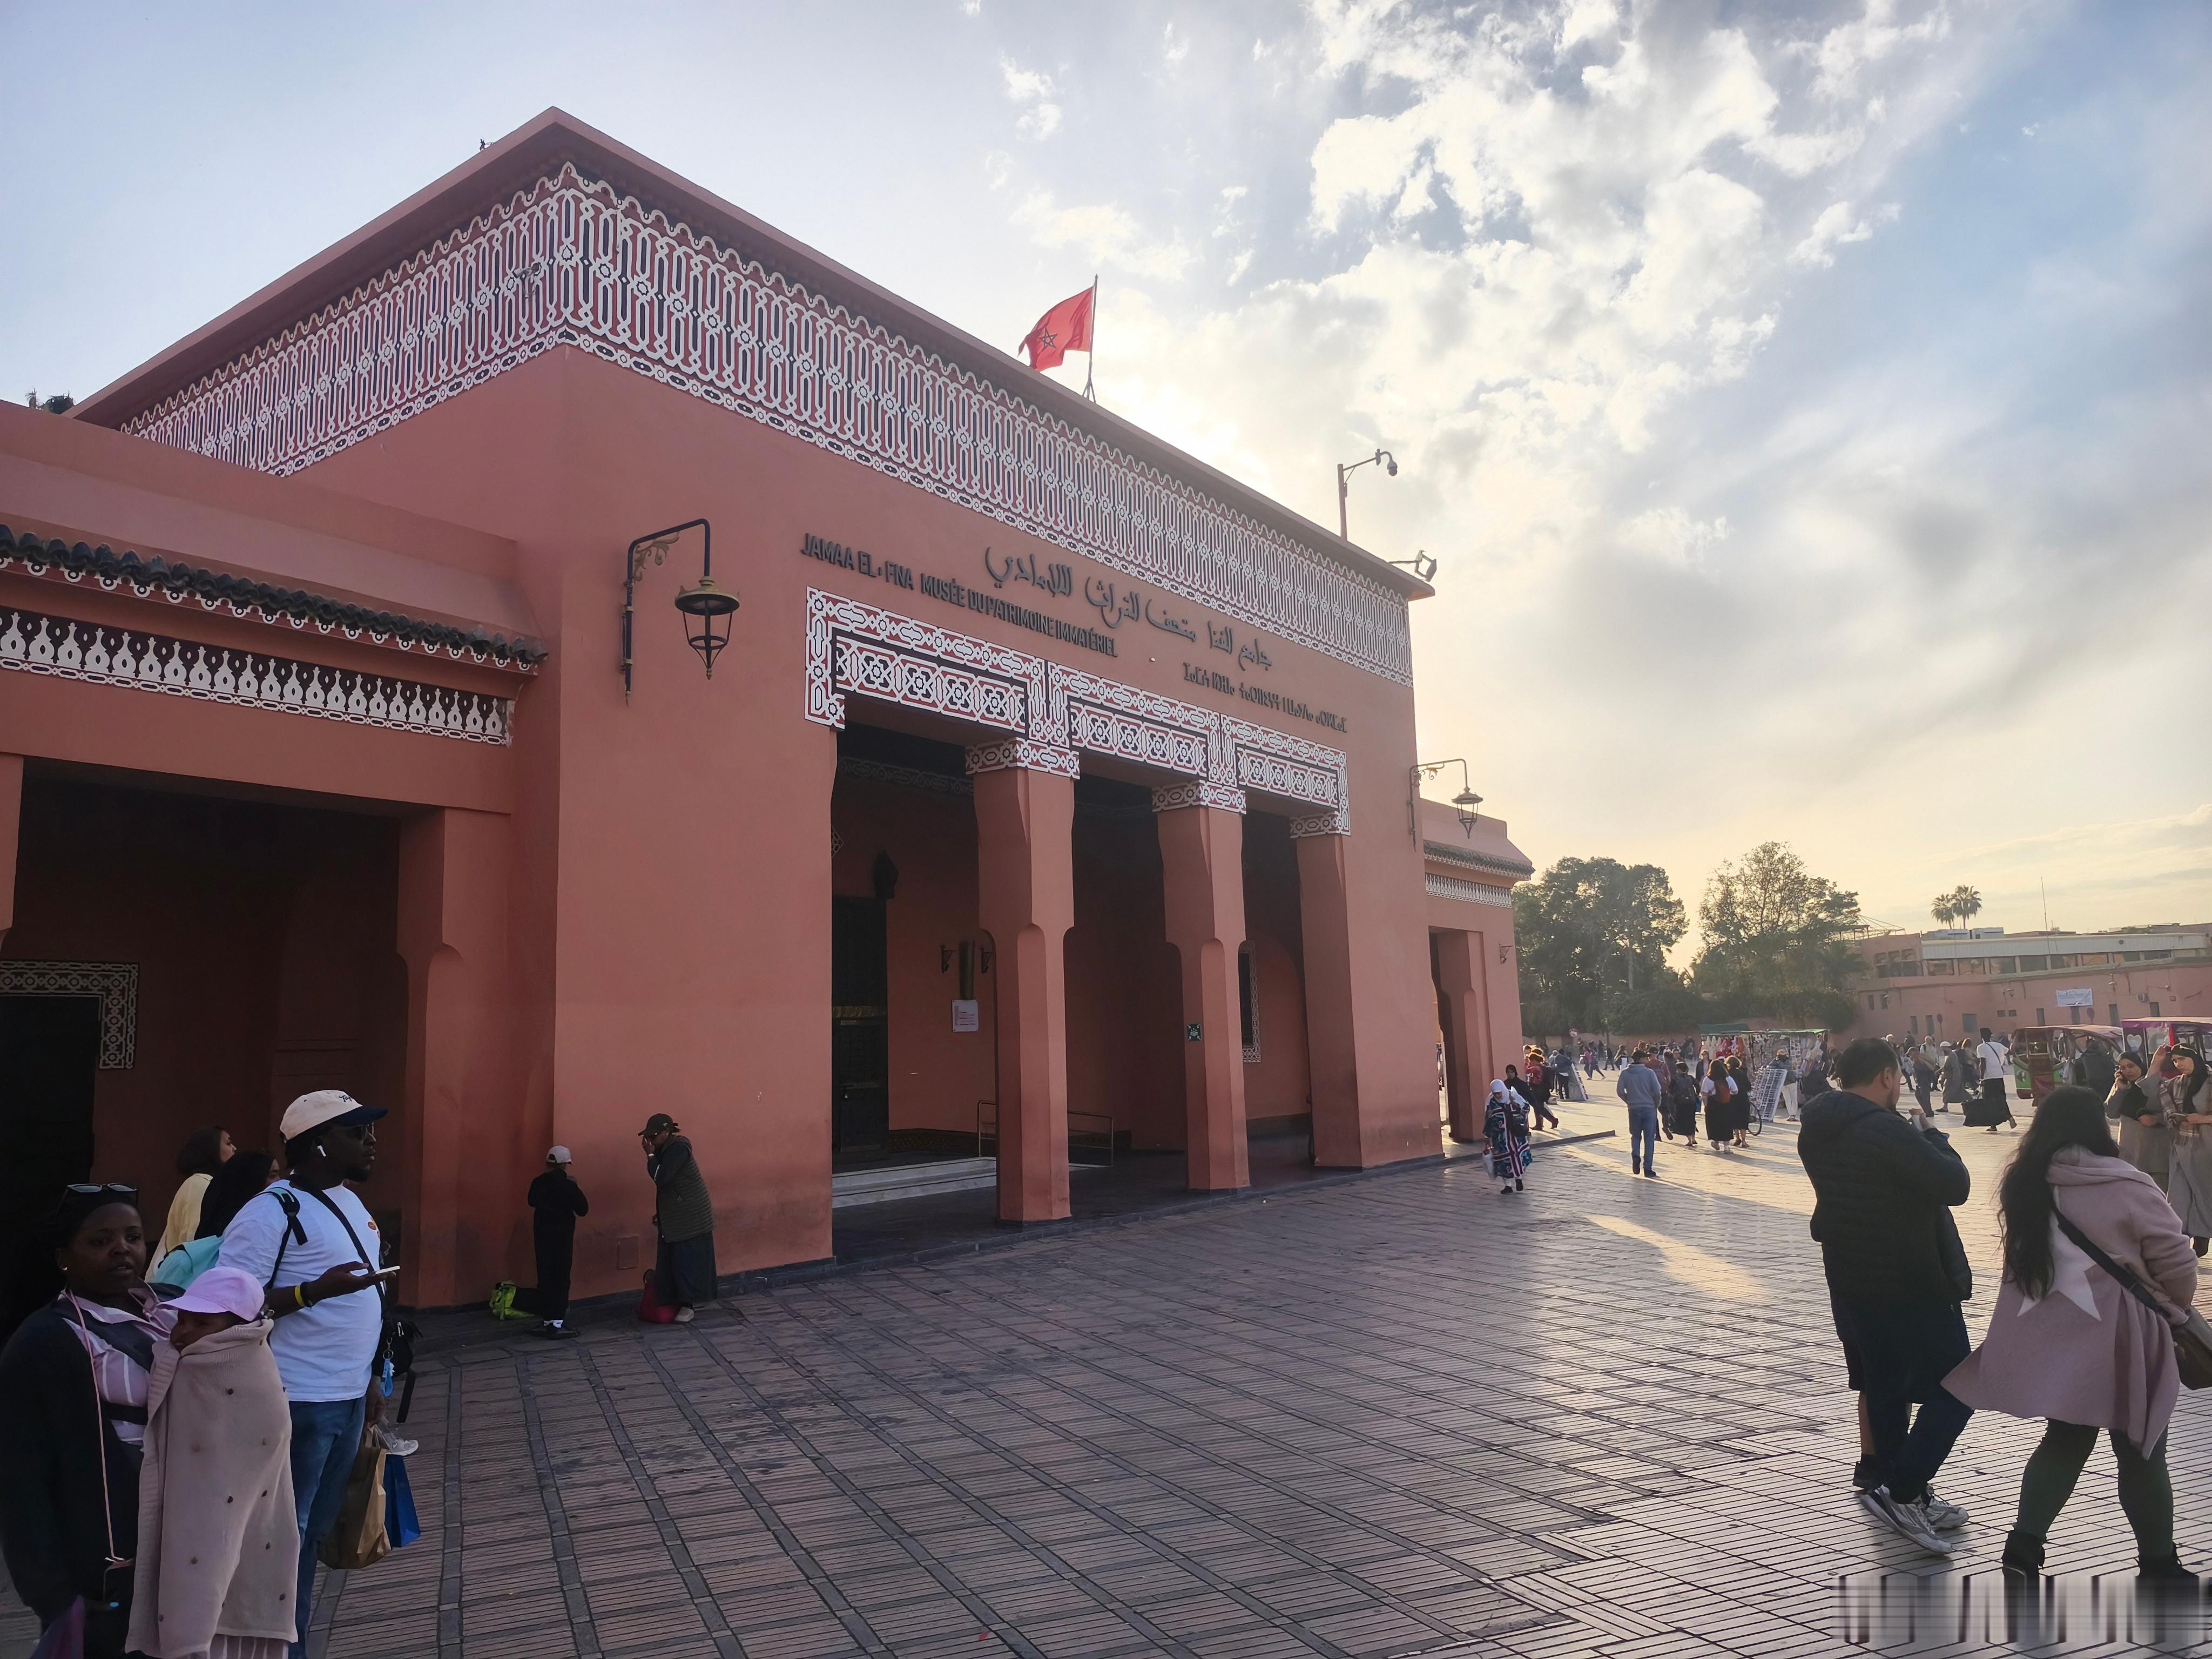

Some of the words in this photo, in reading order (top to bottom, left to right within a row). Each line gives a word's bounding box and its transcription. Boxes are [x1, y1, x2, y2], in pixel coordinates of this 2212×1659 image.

[800, 532, 854, 570] JAMAA
[967, 589, 985, 613] DU
[986, 595, 1055, 637] PATRIMOINE
[984, 546, 1073, 598] اللامادي
[1084, 576, 1141, 629] التراث
[1145, 598, 1197, 643] متحف
[1207, 621, 1233, 655] الفنا
[1238, 638, 1272, 671] جامع
